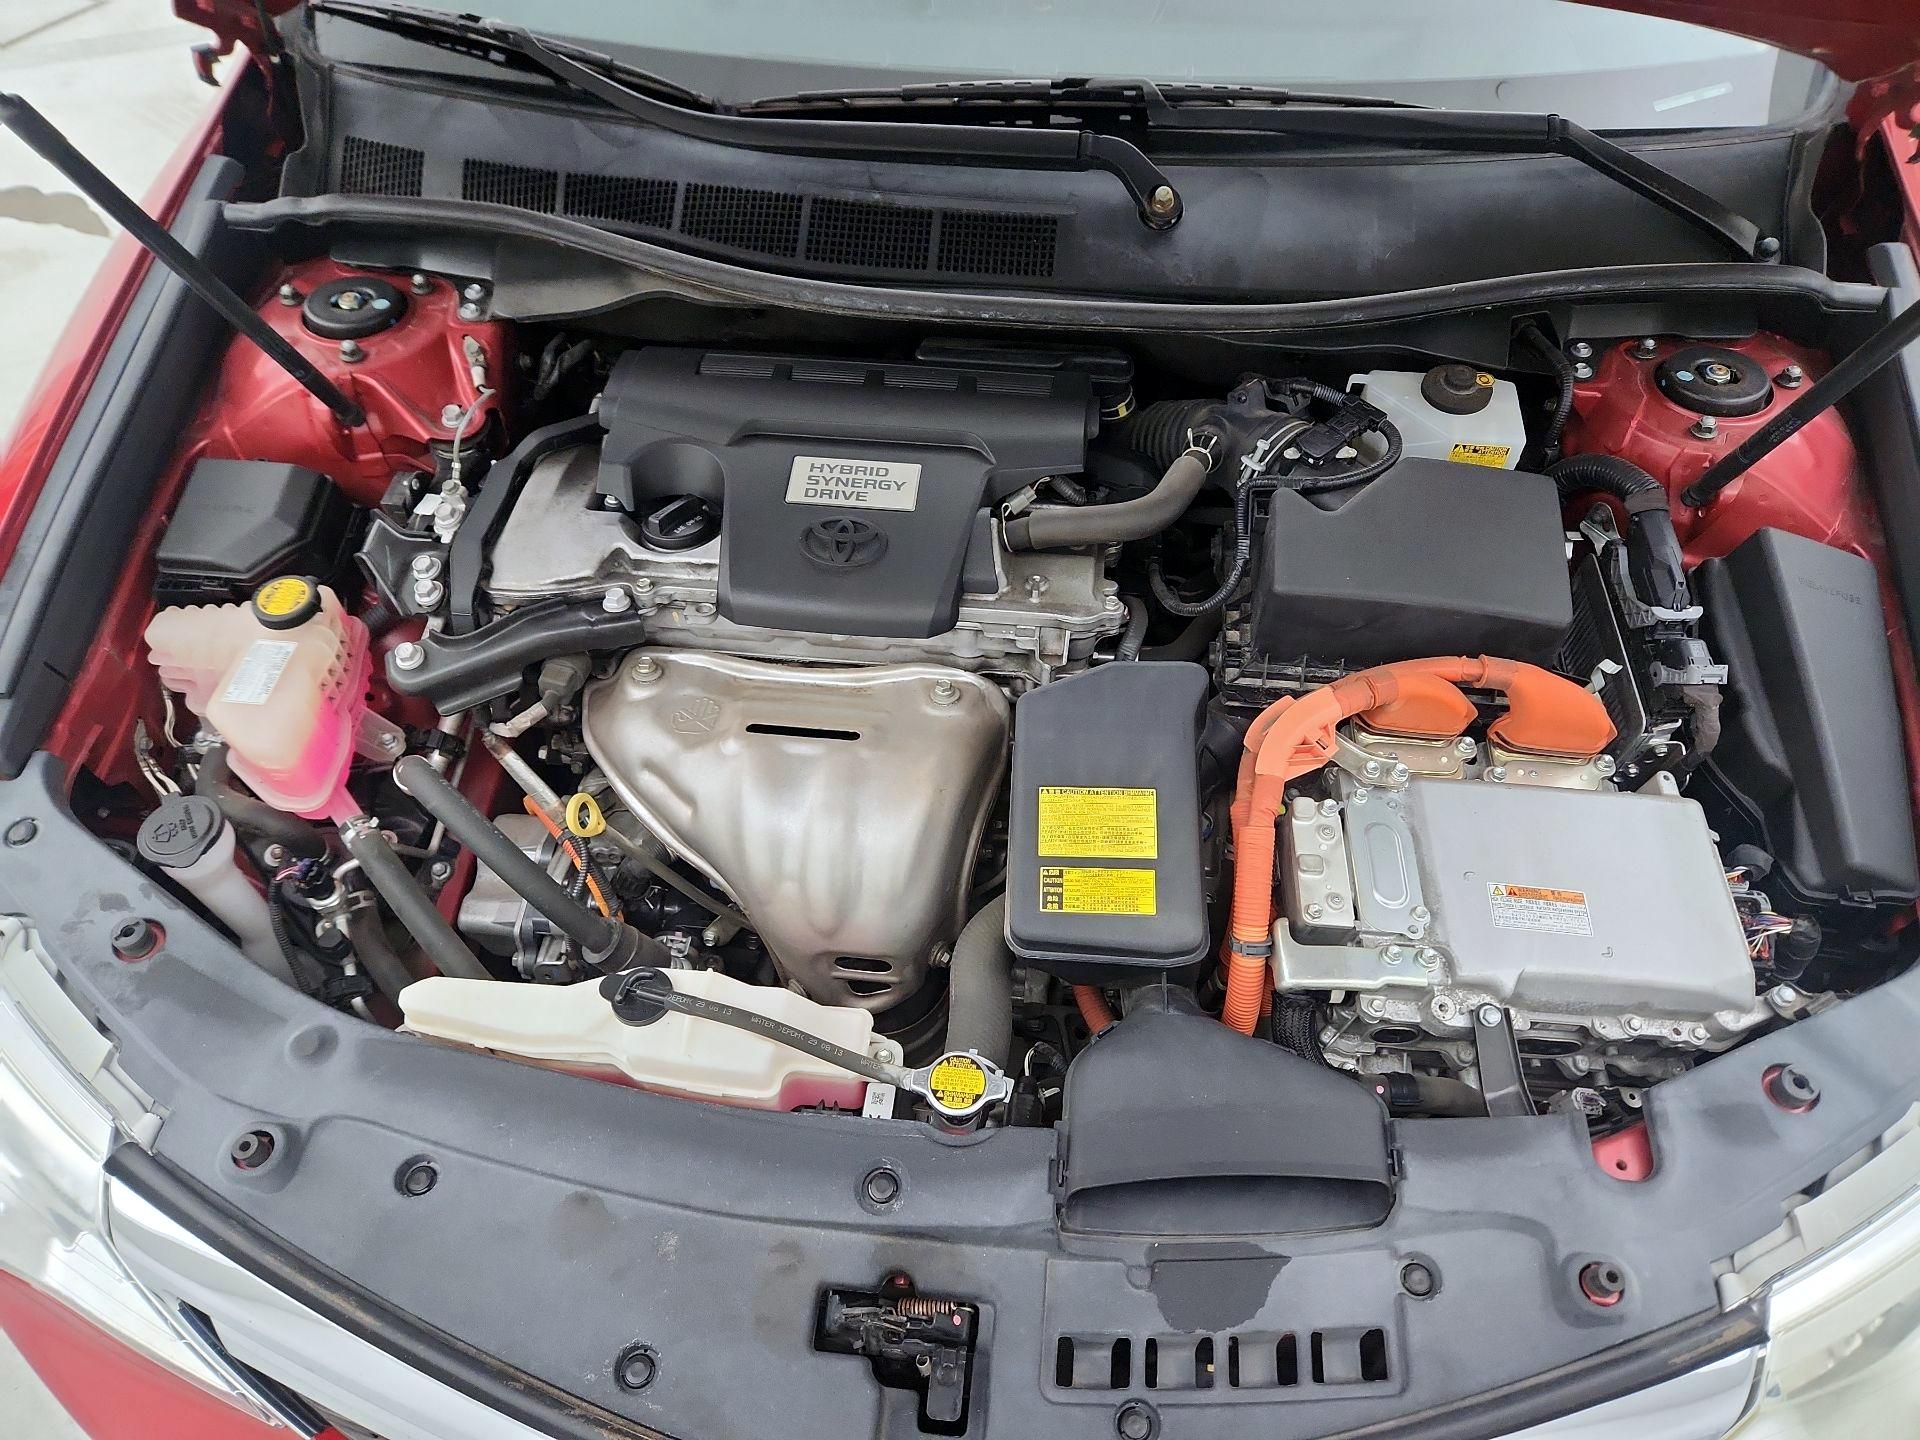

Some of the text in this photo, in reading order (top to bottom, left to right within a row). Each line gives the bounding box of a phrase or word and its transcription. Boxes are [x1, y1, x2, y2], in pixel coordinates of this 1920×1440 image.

[809, 462, 890, 477] HYBRID
[806, 475, 907, 491] SYNERGY
[804, 487, 869, 502] DRIVE
[696, 1000, 706, 1008] 29
[722, 1008, 732, 1016] 13
[751, 1015, 776, 1029] WATER
[808, 1038, 818, 1046] 29
[834, 1048, 844, 1056] 13
[948, 1061, 976, 1070] ATTENTION
[949, 1056, 972, 1064] CAUTION
